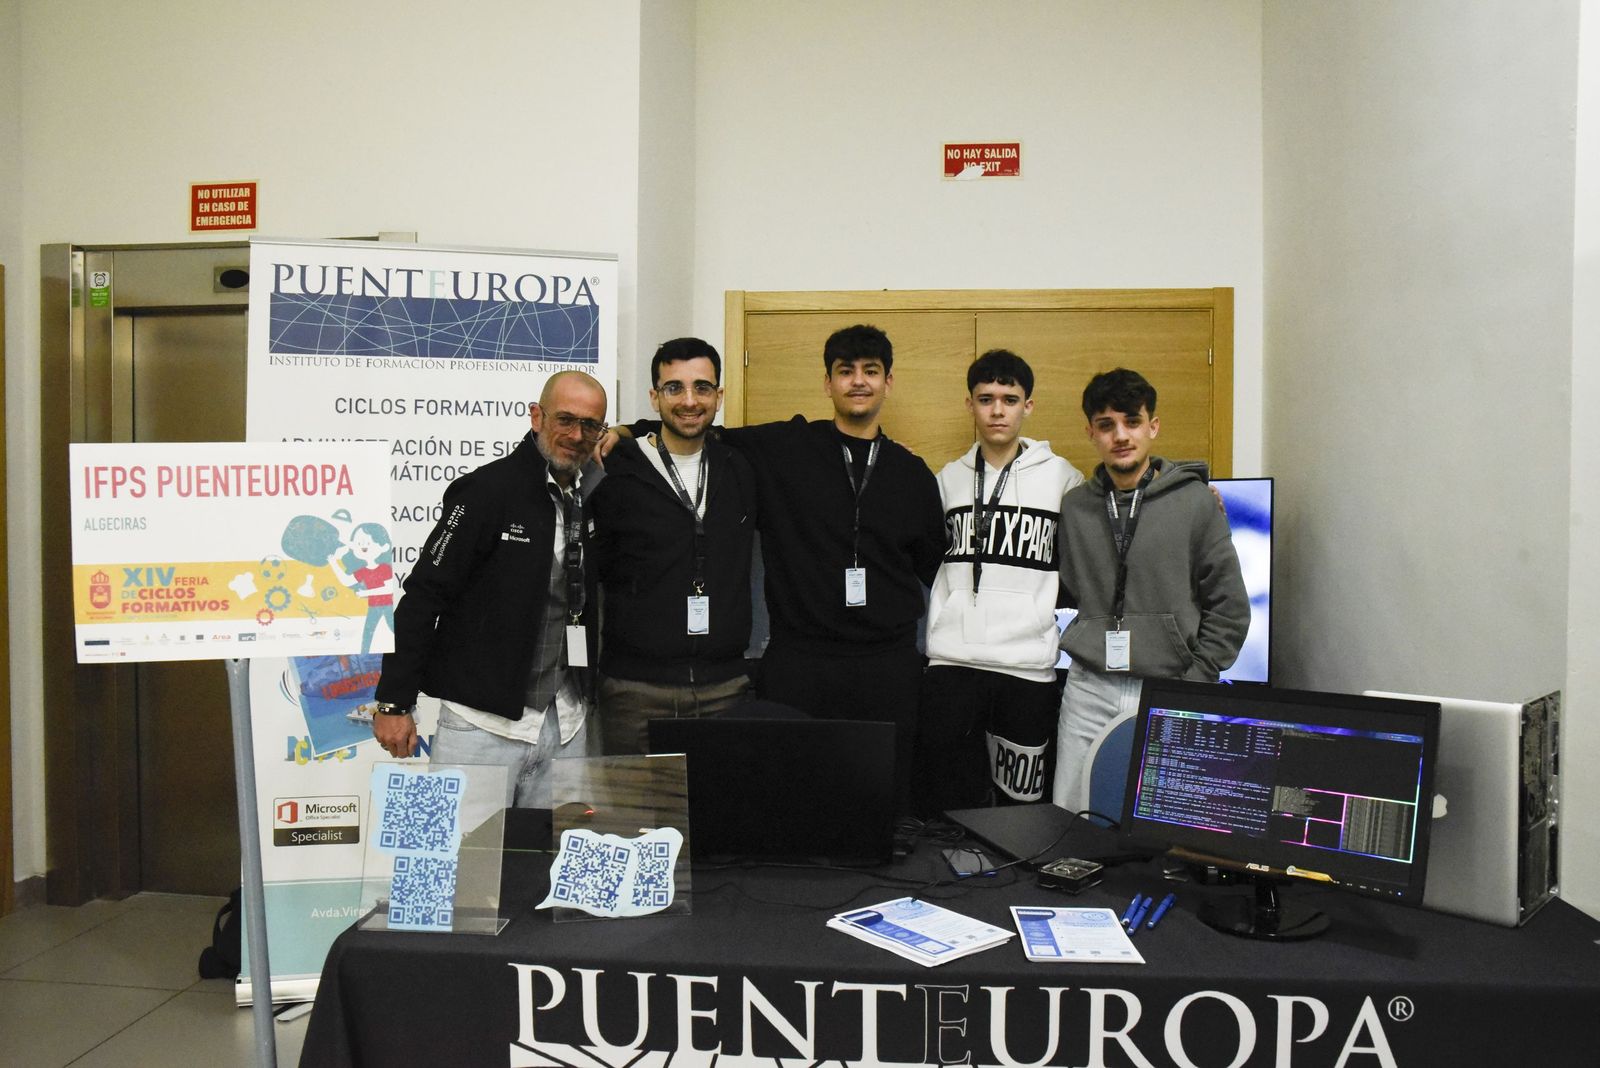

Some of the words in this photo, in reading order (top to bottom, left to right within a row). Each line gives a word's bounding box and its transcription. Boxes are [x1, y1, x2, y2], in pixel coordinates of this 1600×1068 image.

[947, 149, 961, 159] NO
[963, 148, 982, 159] HAY
[984, 148, 1018, 159] SALIDA
[197, 189, 210, 199] NO
[212, 187, 251, 199] UTILIZAR
[199, 202, 210, 213] EN
[211, 201, 236, 212] CASO
[237, 201, 249, 211] DE
[195, 214, 252, 226] EMERGENCIA
[269, 355, 341, 368] INSTITUTO
[345, 358, 362, 368] DE
[366, 357, 446, 370] FORMACIÓN
[450, 359, 534, 373] PROFESIONAL
[335, 397, 407, 415] CICLOS
[460, 440, 485, 457] DE
[84, 465, 147, 499] IFPS
[157, 463, 354, 498] PUENTEUROPA
[84, 516, 147, 531] ALGECIRAS
[122, 566, 176, 588] XIV
[174, 576, 209, 586] FERIA
[121, 590, 138, 600] DE
[138, 587, 196, 601] CICLOS
[121, 599, 230, 614] FORMATIVOS
[995, 742, 1044, 795] PROJE
[305, 803, 357, 814] Microsoft
[291, 830, 343, 844] Specialist
[1245, 863, 1270, 873] ASUS
